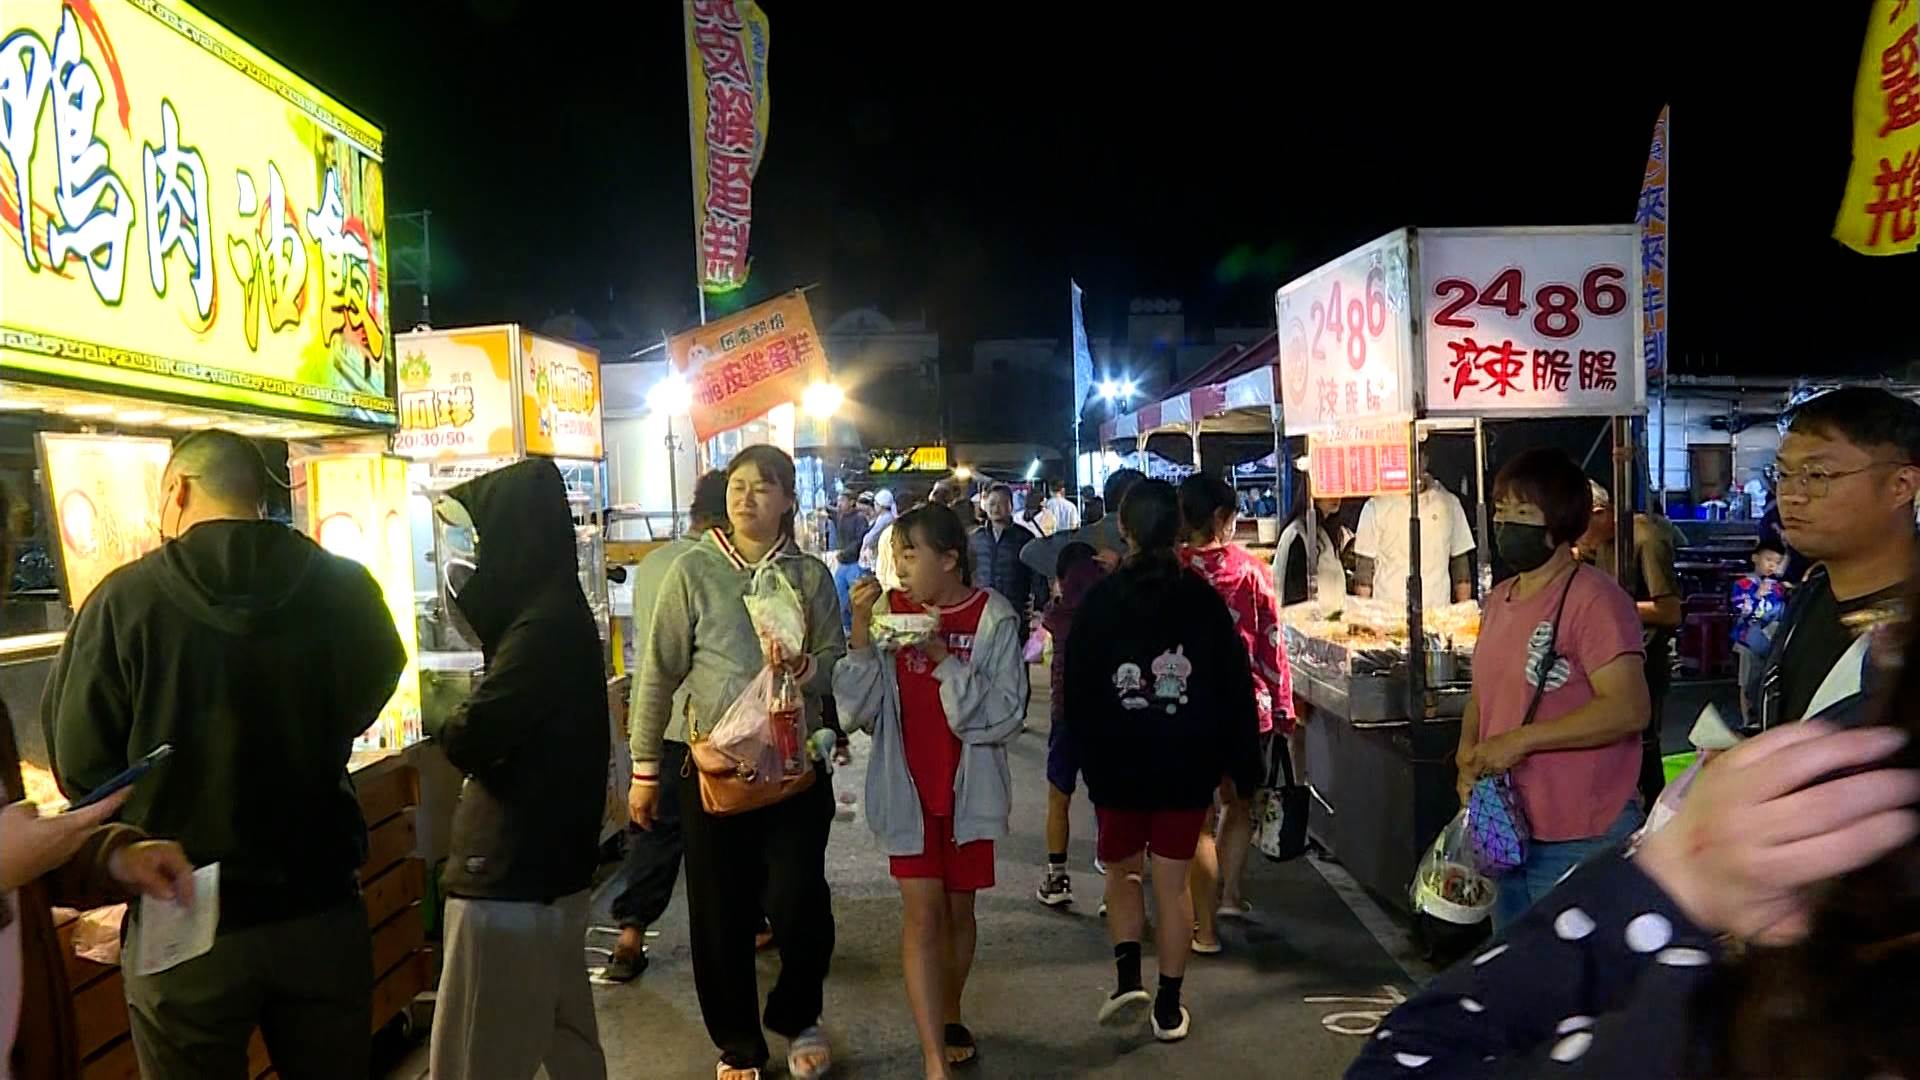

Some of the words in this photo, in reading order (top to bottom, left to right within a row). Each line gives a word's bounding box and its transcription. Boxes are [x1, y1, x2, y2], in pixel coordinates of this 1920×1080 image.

[1308, 266, 1388, 370] 2486
[1433, 267, 1628, 338] 2486
[1444, 337, 1618, 399] 辣脆腸
